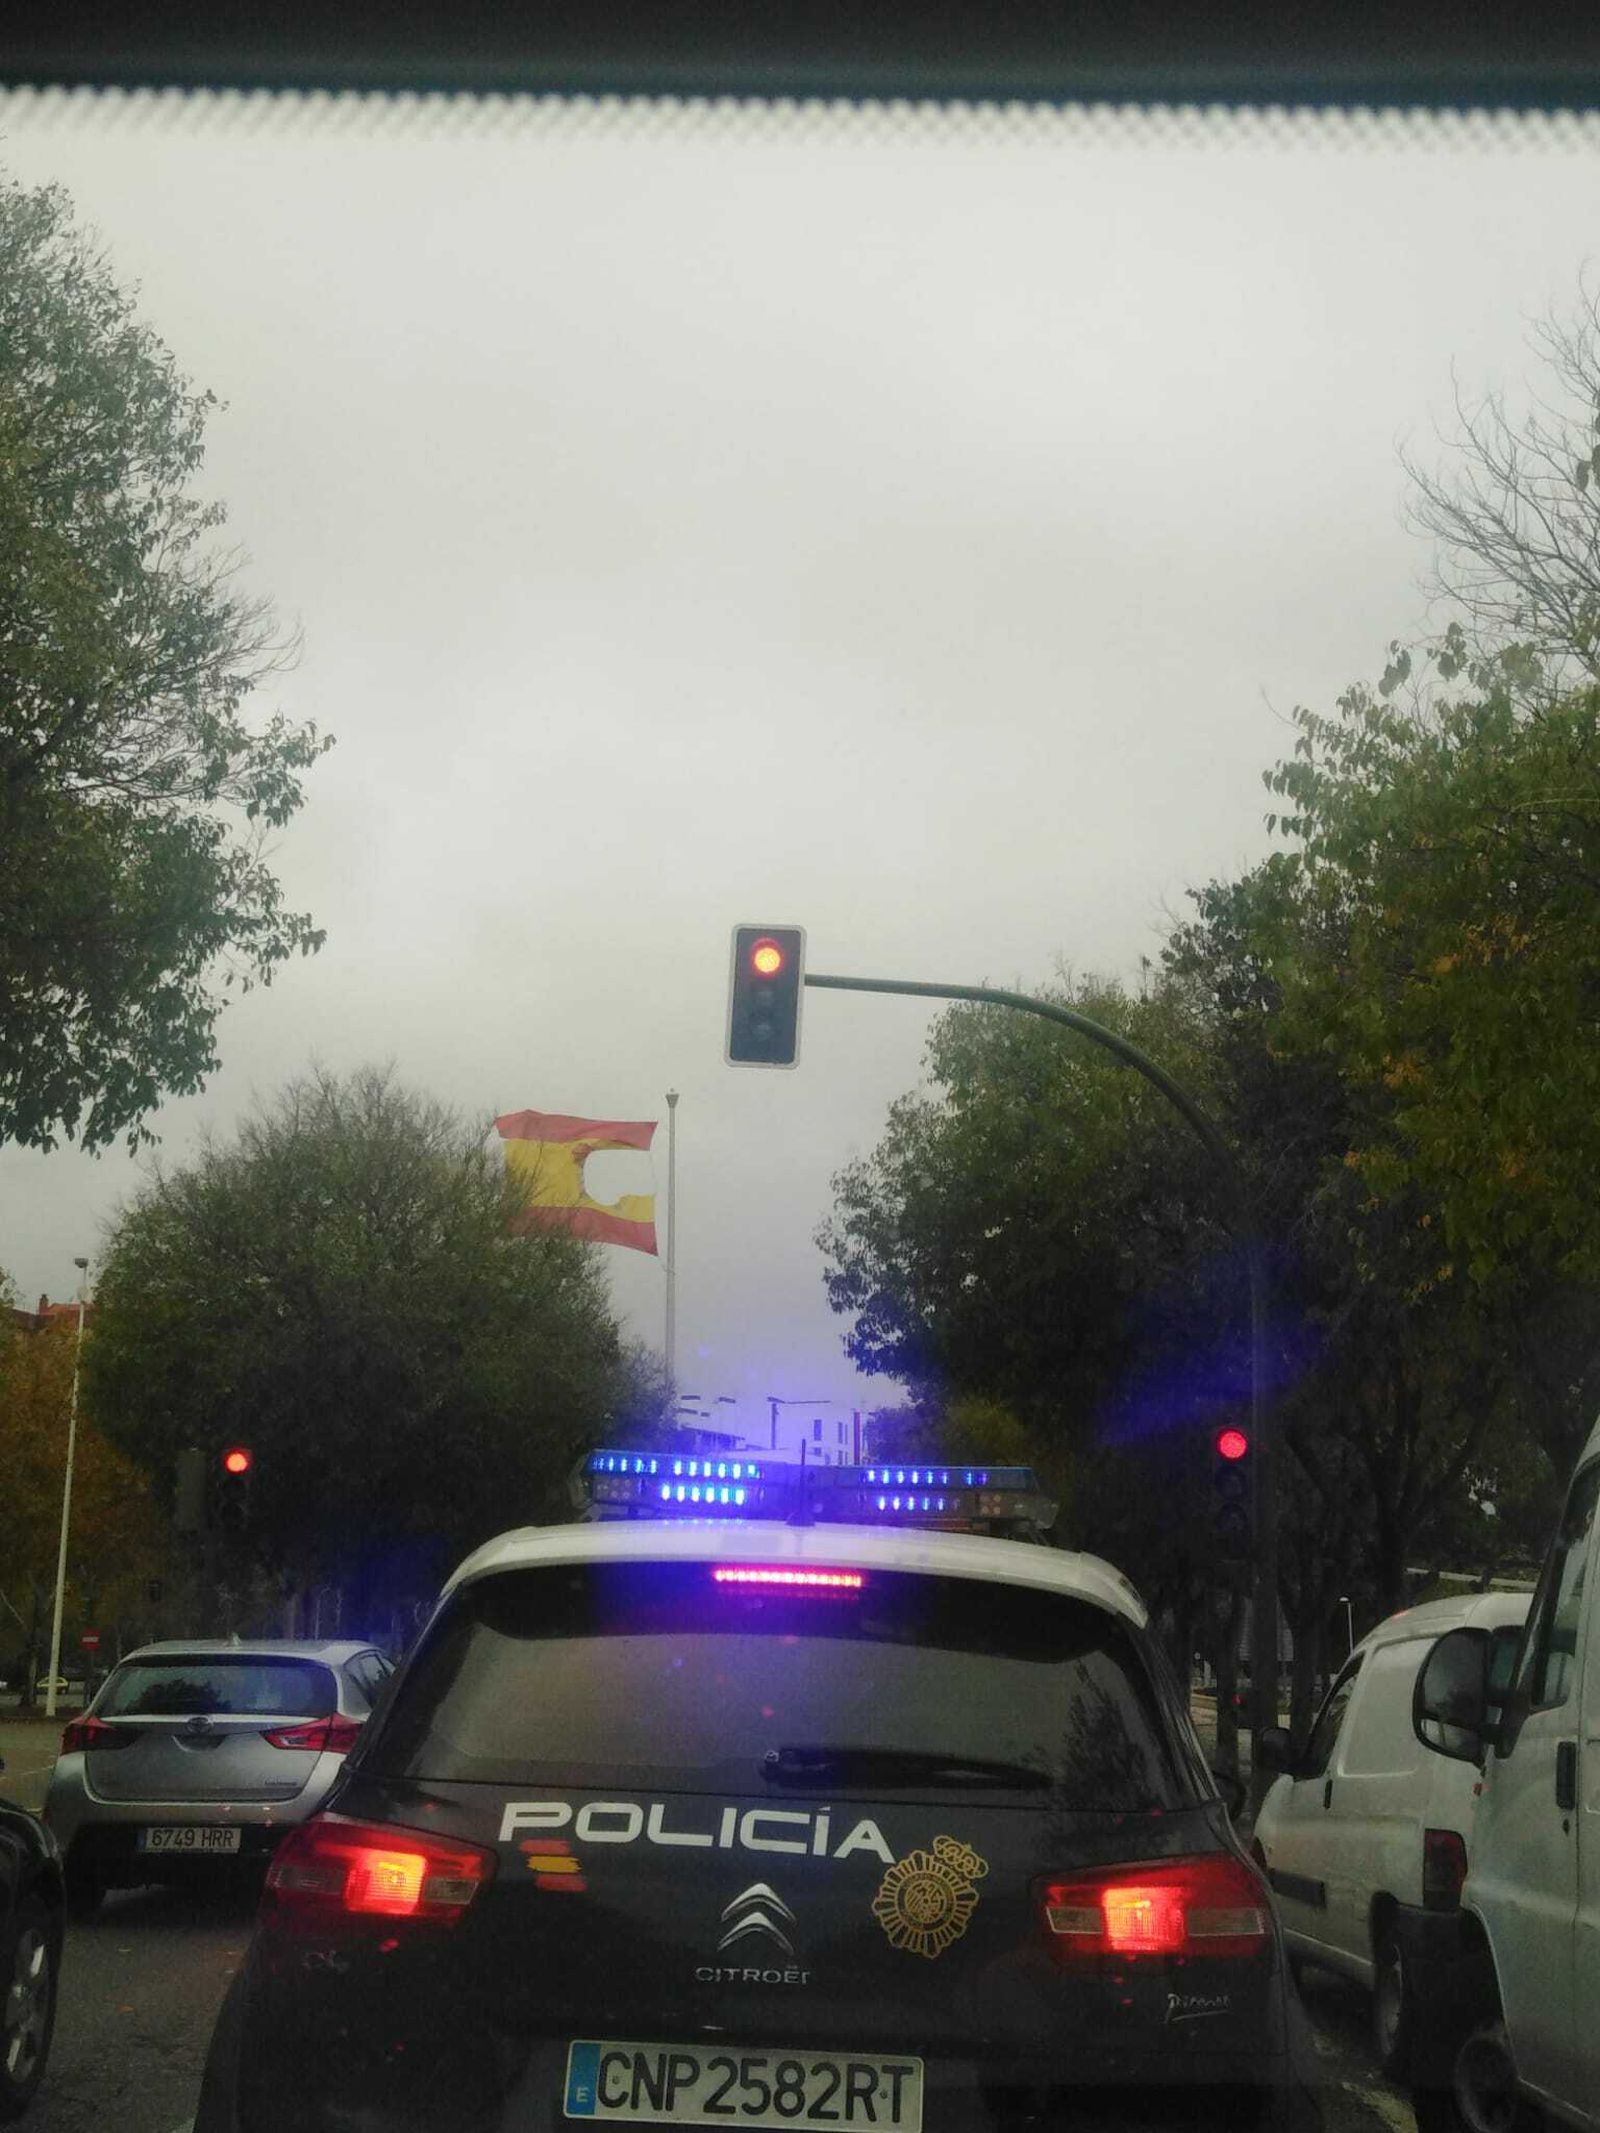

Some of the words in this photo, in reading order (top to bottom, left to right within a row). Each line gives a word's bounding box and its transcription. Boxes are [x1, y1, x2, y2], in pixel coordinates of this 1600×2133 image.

[151, 1829, 195, 1847] 6749
[201, 1829, 234, 1847] HRR
[499, 1801, 895, 1864] POLICÍA
[576, 2086, 589, 2102] E
[598, 2051, 914, 2122] CNP2582RT
